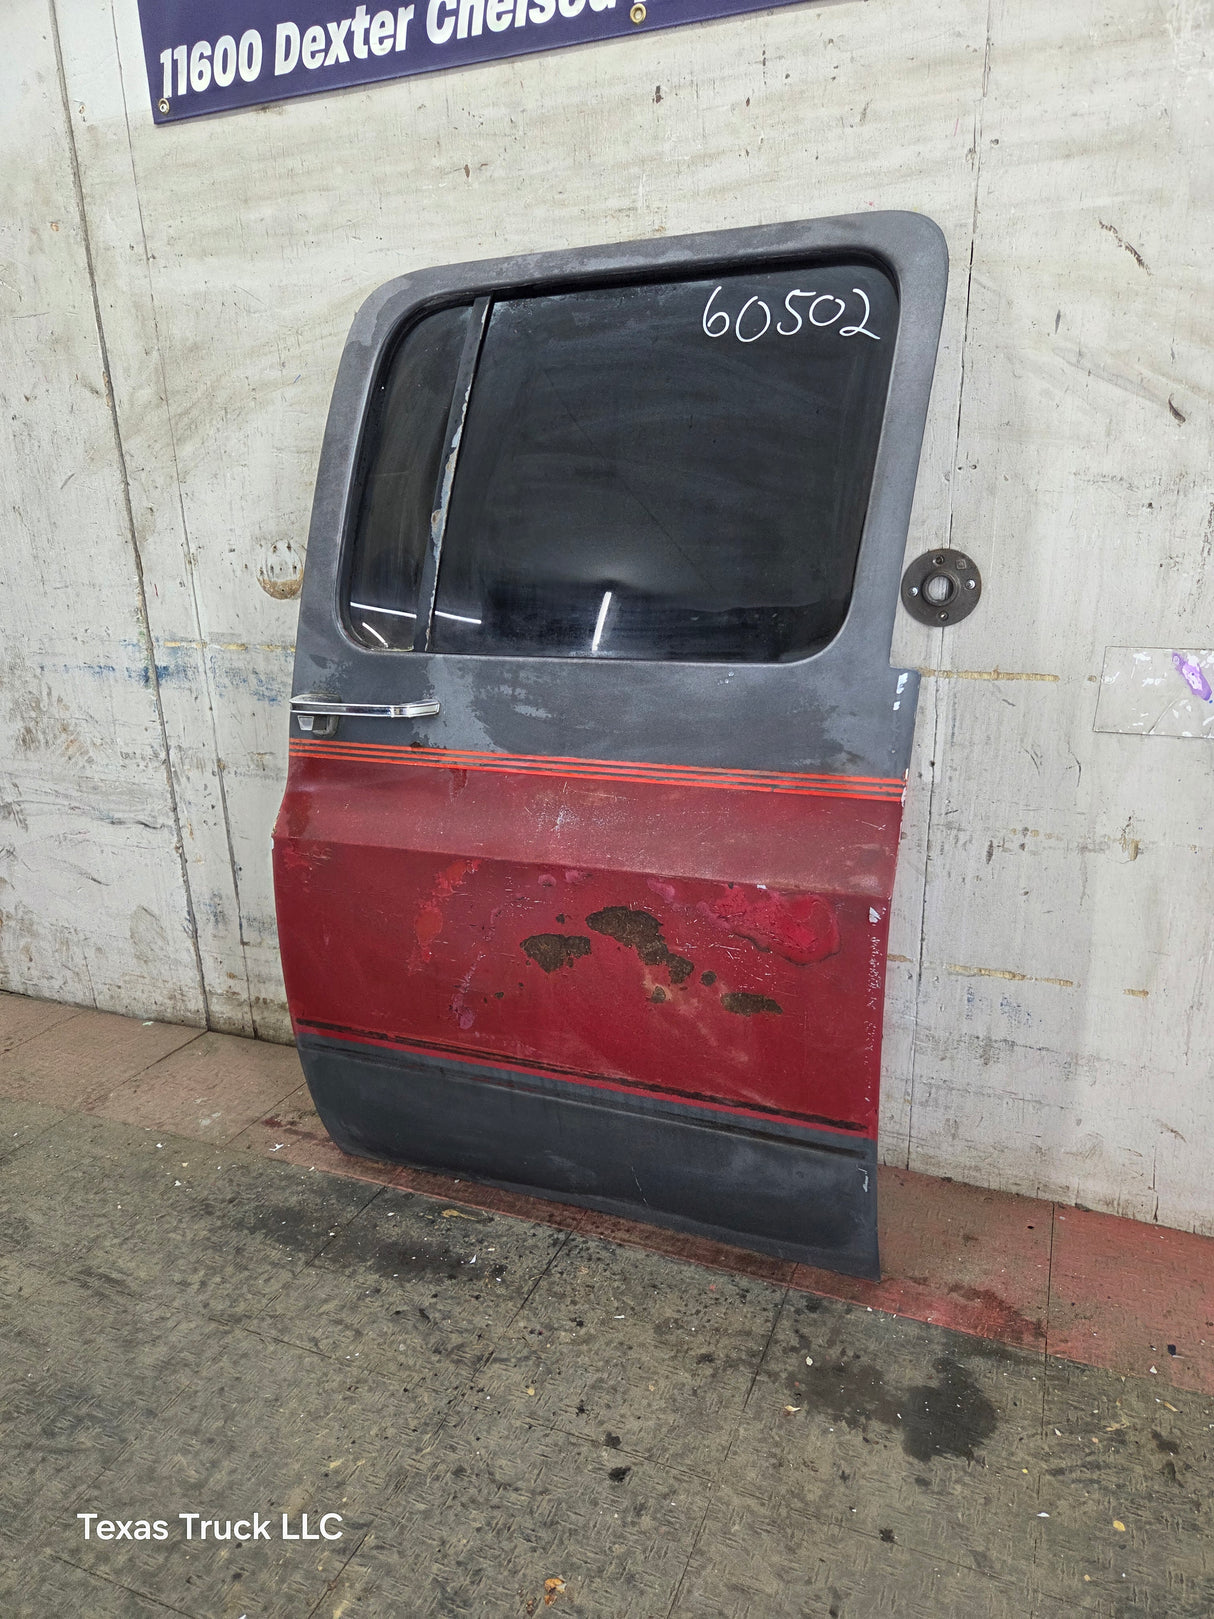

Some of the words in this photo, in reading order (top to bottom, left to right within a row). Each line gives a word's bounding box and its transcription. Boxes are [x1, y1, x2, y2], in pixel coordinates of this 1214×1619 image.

[159, 28, 263, 98] 11600
[274, 4, 414, 76] Dexter
[702, 285, 881, 343] 60502
